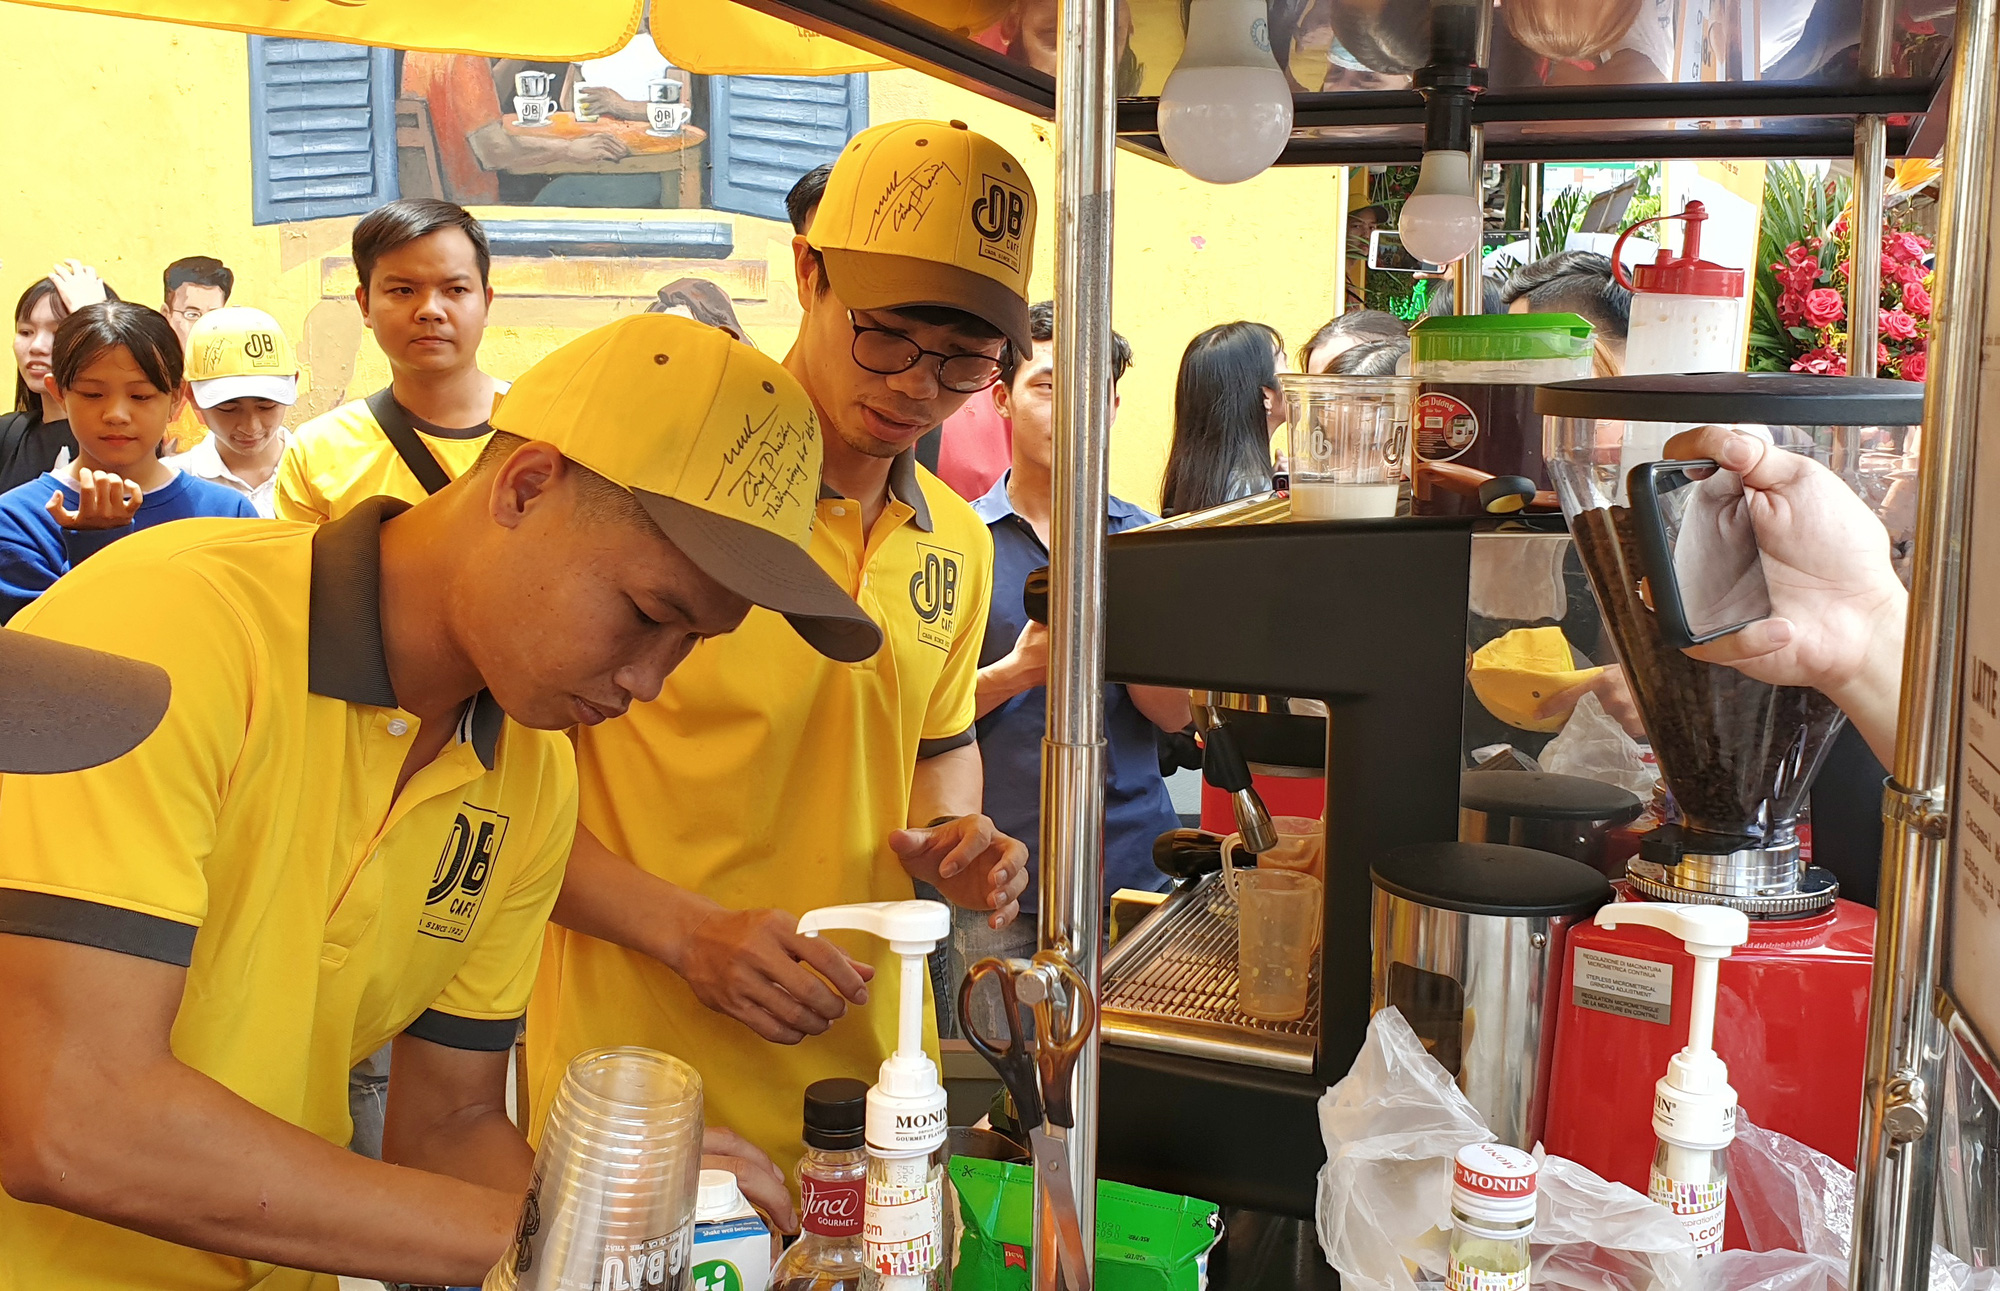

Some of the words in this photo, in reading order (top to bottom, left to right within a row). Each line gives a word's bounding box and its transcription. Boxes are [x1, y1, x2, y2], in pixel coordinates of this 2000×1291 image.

[426, 921, 448, 933] SINCE
[448, 926, 464, 936] 1922
[1582, 952, 1619, 966] REGOLAZIONE
[1626, 962, 1662, 973] MACINATURA
[1587, 961, 1627, 973] MICROMETRICA
[1628, 967, 1656, 978] CONTINUA
[1586, 974, 1611, 983] STEPLESS
[1613, 979, 1656, 992] MICROMETRICAL
[1590, 981, 1615, 991] GRINDING
[1616, 986, 1652, 998] ADJUSTMENT
[1581, 992, 1614, 1004] REGULATION
[1598, 1001, 1623, 1013] MOUTURE
[1633, 1008, 1659, 1020] CONTINU
[1462, 1171, 1530, 1192] MONIN
[818, 1216, 854, 1226] GOURMET
[1004, 1250, 1024, 1260] new
